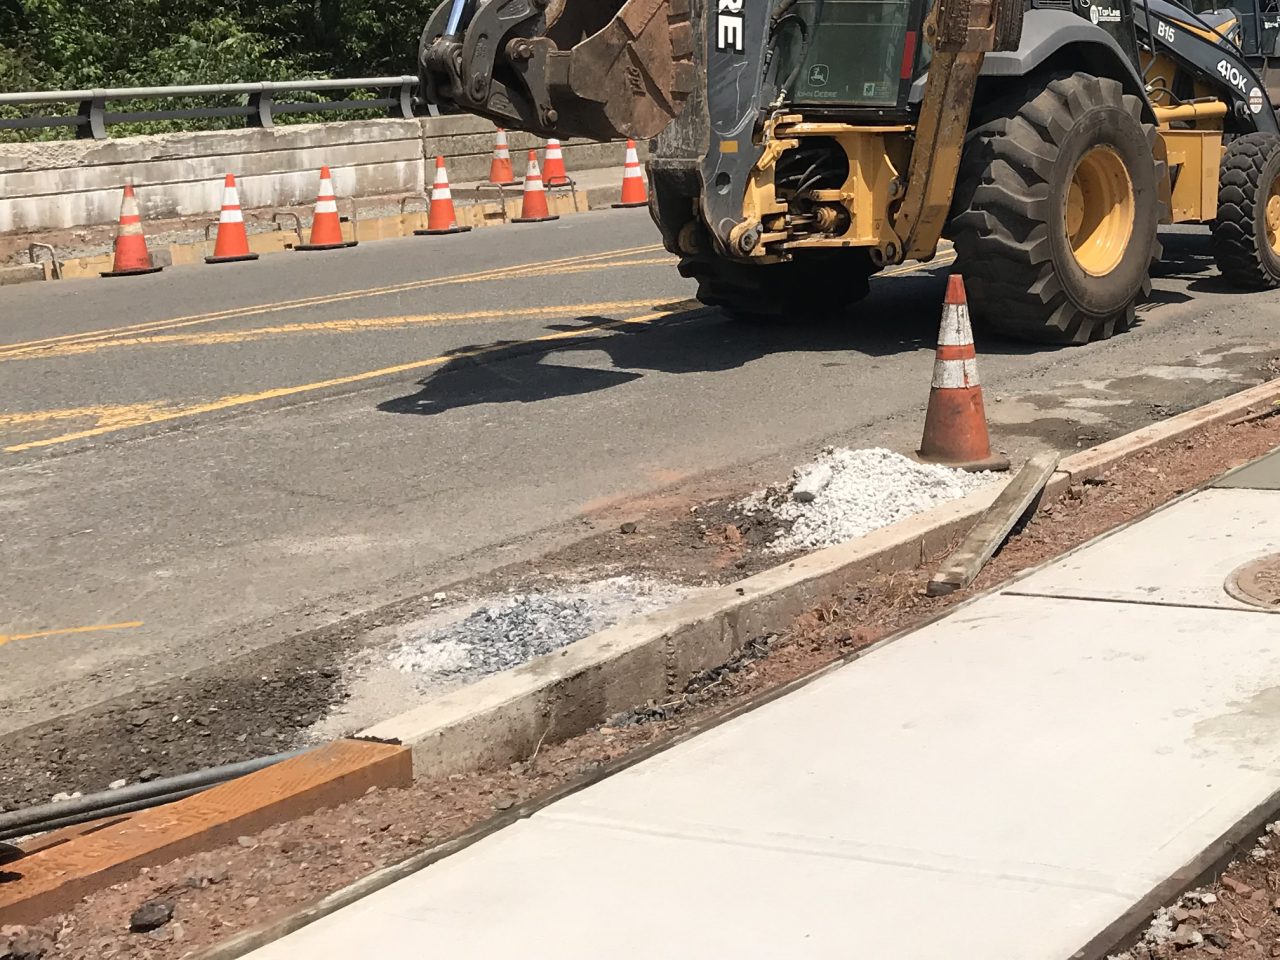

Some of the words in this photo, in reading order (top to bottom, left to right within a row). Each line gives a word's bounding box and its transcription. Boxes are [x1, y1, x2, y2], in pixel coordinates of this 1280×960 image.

[1157, 21, 1175, 43] B15
[1217, 59, 1247, 93] 410K
[814, 90, 838, 98] DEERE
